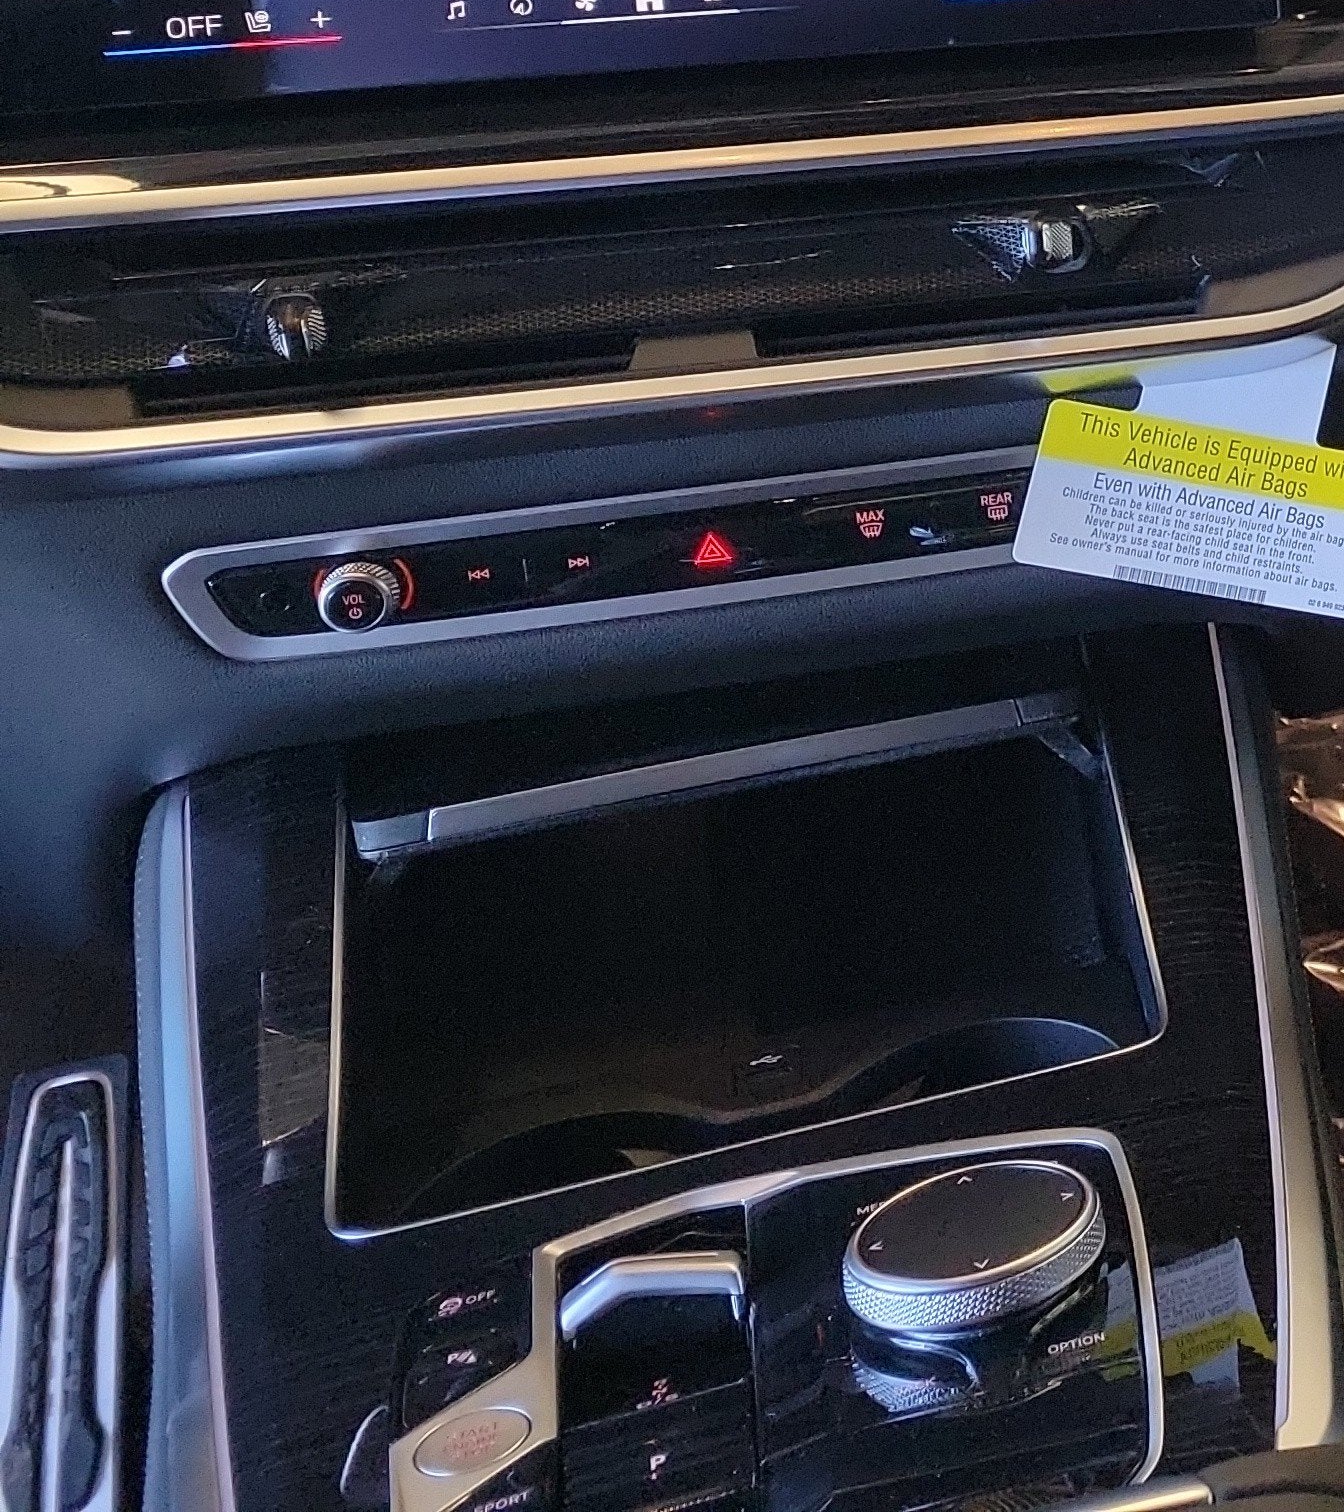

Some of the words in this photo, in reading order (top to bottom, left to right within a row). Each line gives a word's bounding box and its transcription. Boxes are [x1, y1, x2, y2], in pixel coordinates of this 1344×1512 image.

[166, 14, 223, 39] OFF
[1080, 412, 1121, 438] This
[1129, 420, 1198, 452] Vehicle
[1204, 435, 1221, 456] is
[1227, 439, 1319, 474] Equipped
[1123, 447, 1221, 482] Advanced
[1225, 465, 1256, 488] Air
[1260, 471, 1308, 500] Bags
[855, 508, 885, 524] MAX
[979, 491, 1013, 507] REAR
[1062, 486, 1105, 504] Children
[1108, 496, 1127, 507] can
[1129, 498, 1143, 510] be
[1145, 501, 1173, 515] killed
[1175, 507, 1187, 518] or
[1190, 510, 1236, 527] seriously
[1238, 518, 1273, 533] injured
[1276, 524, 1289, 536] by
[1291, 527, 1307, 539] the
[1309, 530, 1324, 542] air
[1094, 472, 1133, 495] Even
[1138, 483, 1172, 502] with
[1175, 487, 1256, 516] Advanced
[1258, 502, 1283, 521] Air
[1286, 506, 1325, 530] Bags
[1084, 514, 1115, 529] Never
[1117, 521, 1135, 533] put
[1146, 526, 1202, 546] rear-facing
[1204, 536, 1230, 549] child
[1232, 541, 1254, 554] seat
[1256, 544, 1267, 555] in
[1269, 547, 1285, 559] the
[1287, 550, 1315, 564] front.
[1089, 503, 1108, 516] The
[1110, 507, 1135, 520] back
[1137, 512, 1159, 525] seat
[1161, 516, 1171, 527] is
[1174, 519, 1190, 531] the
[1192, 522, 1224, 537] safest
[1226, 528, 1251, 542] place
[1256, 532, 1271, 545] for
[1273, 535, 1316, 553] children.
[1090, 527, 1128, 544] Always
[1130, 536, 1149, 547] use
[1151, 539, 1174, 552] seat
[1175, 542, 1201, 556] belts
[1202, 547, 1223, 560] and
[1224, 551, 1251, 565] child
[1252, 556, 1303, 574] restraints.
[1049, 532, 1069, 546] See
[1071, 537, 1113, 553] owner's
[1114, 545, 1152, 560] manual
[1155, 551, 1171, 563] for
[1173, 556, 1200, 569] more
[1202, 559, 1261, 578] information
[1263, 571, 1293, 585] about
[1295, 576, 1309, 587] air
[1311, 579, 1338, 592] bags.
[341, 593, 366, 606] VOL
[1047, 1331, 1106, 1355] OPTION
[650, 1453, 667, 1471] P
